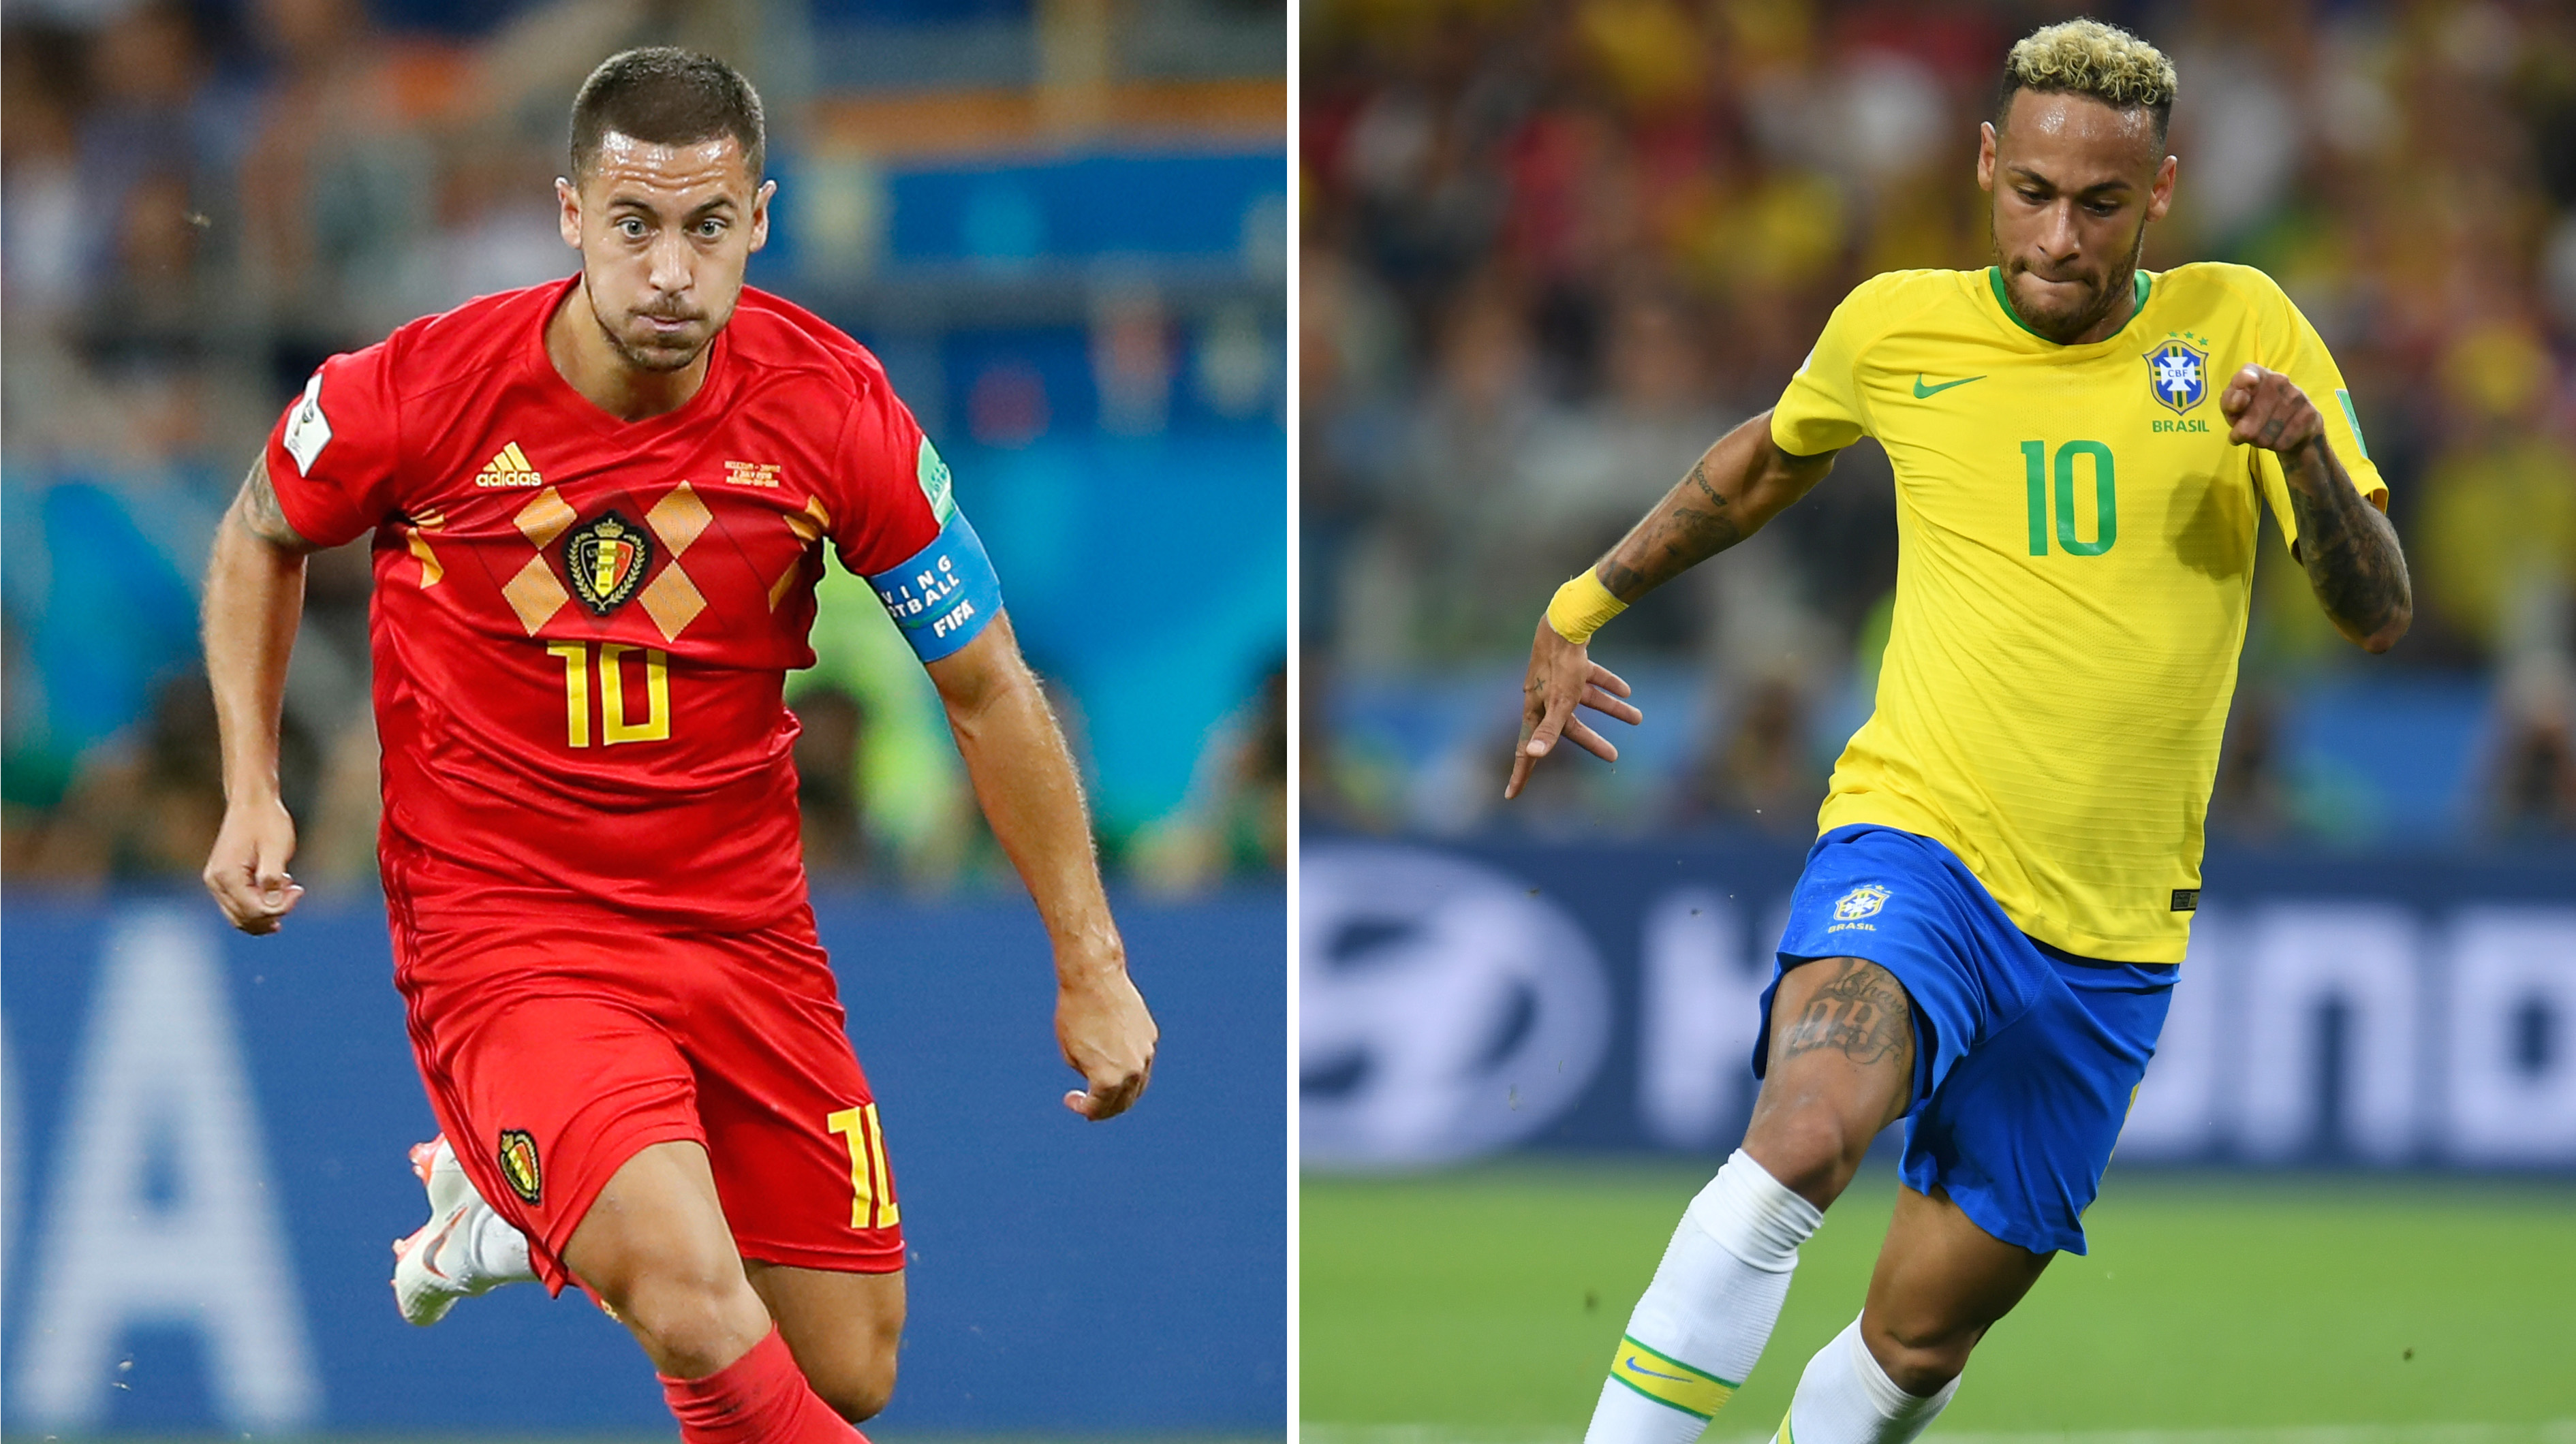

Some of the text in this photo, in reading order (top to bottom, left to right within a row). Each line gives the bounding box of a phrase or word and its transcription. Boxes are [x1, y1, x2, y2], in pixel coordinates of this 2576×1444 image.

[2152, 420, 2209, 433] BRASIL
[476, 471, 542, 487] adidas
[2021, 440, 2117, 556] 10
[933, 599, 975, 638] FIFA
[547, 640, 670, 747] 10
[1828, 922, 1877, 934] BRASIL
